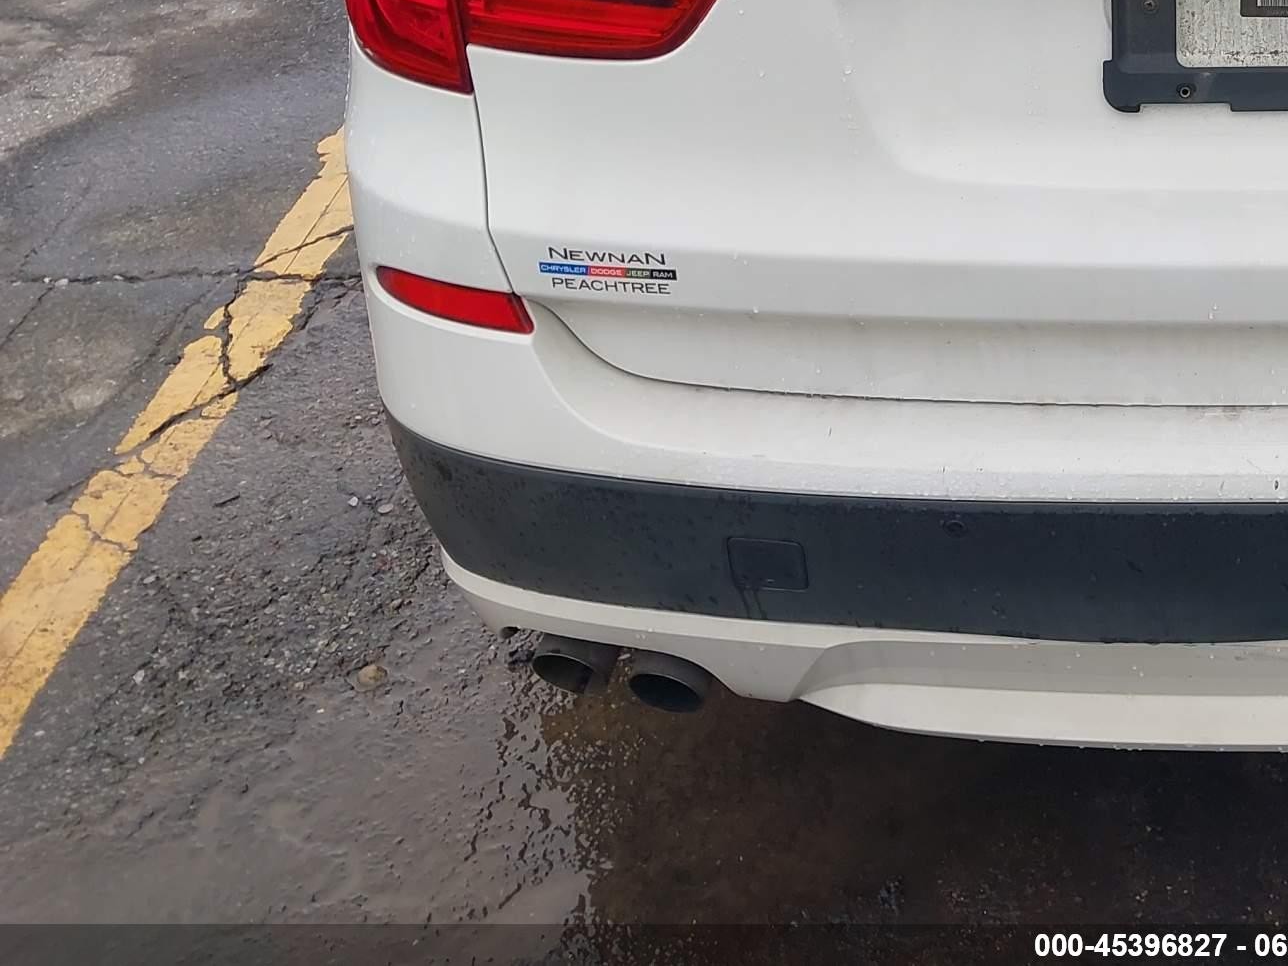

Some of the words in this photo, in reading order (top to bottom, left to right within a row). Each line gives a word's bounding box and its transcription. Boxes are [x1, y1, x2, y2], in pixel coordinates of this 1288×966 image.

[548, 246, 666, 265] NEWNAN
[540, 264, 586, 274] CHRYSLER
[590, 268, 622, 277] DODGE
[626, 269, 650, 277] JEEP
[652, 271, 673, 279] RAM
[551, 277, 671, 295] PEACHTREE
